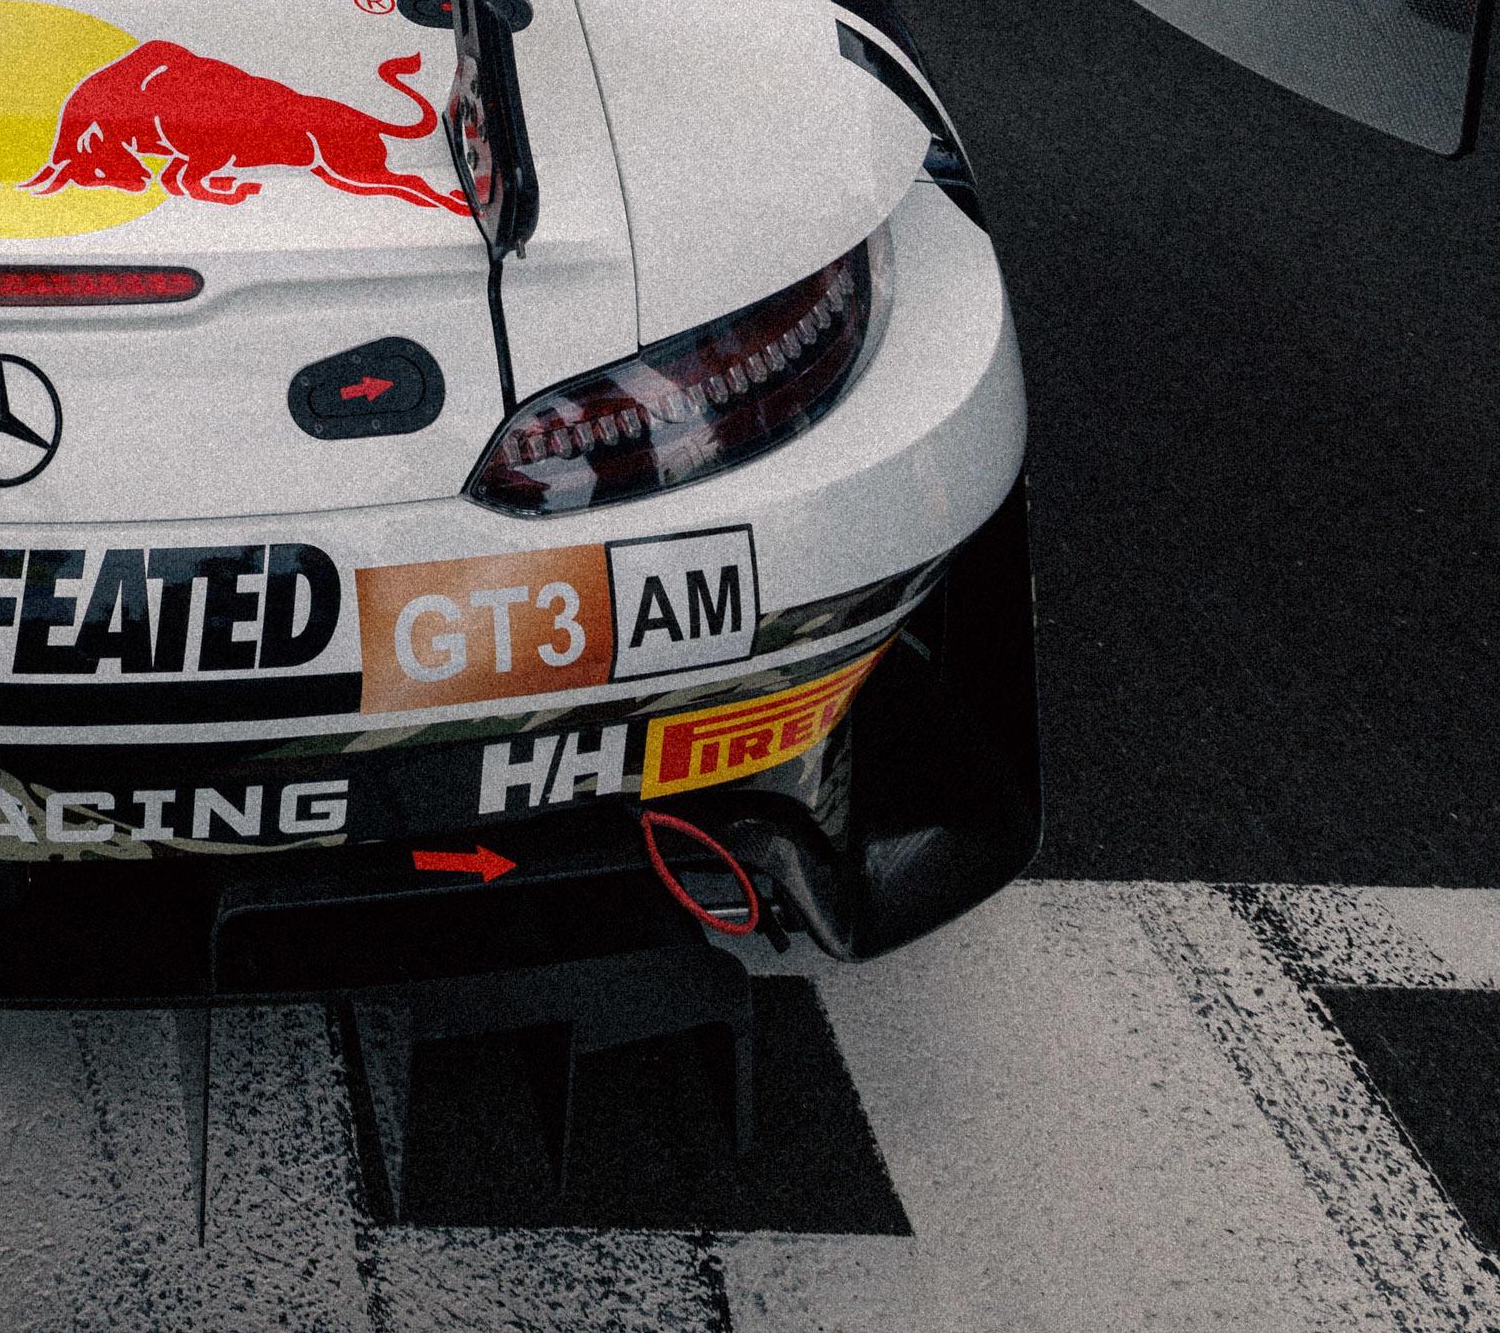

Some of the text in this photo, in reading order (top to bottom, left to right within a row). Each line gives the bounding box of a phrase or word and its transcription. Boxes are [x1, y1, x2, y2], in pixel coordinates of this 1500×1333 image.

[393, 564, 742, 684] GT3 AM
[478, 723, 627, 815] HH
